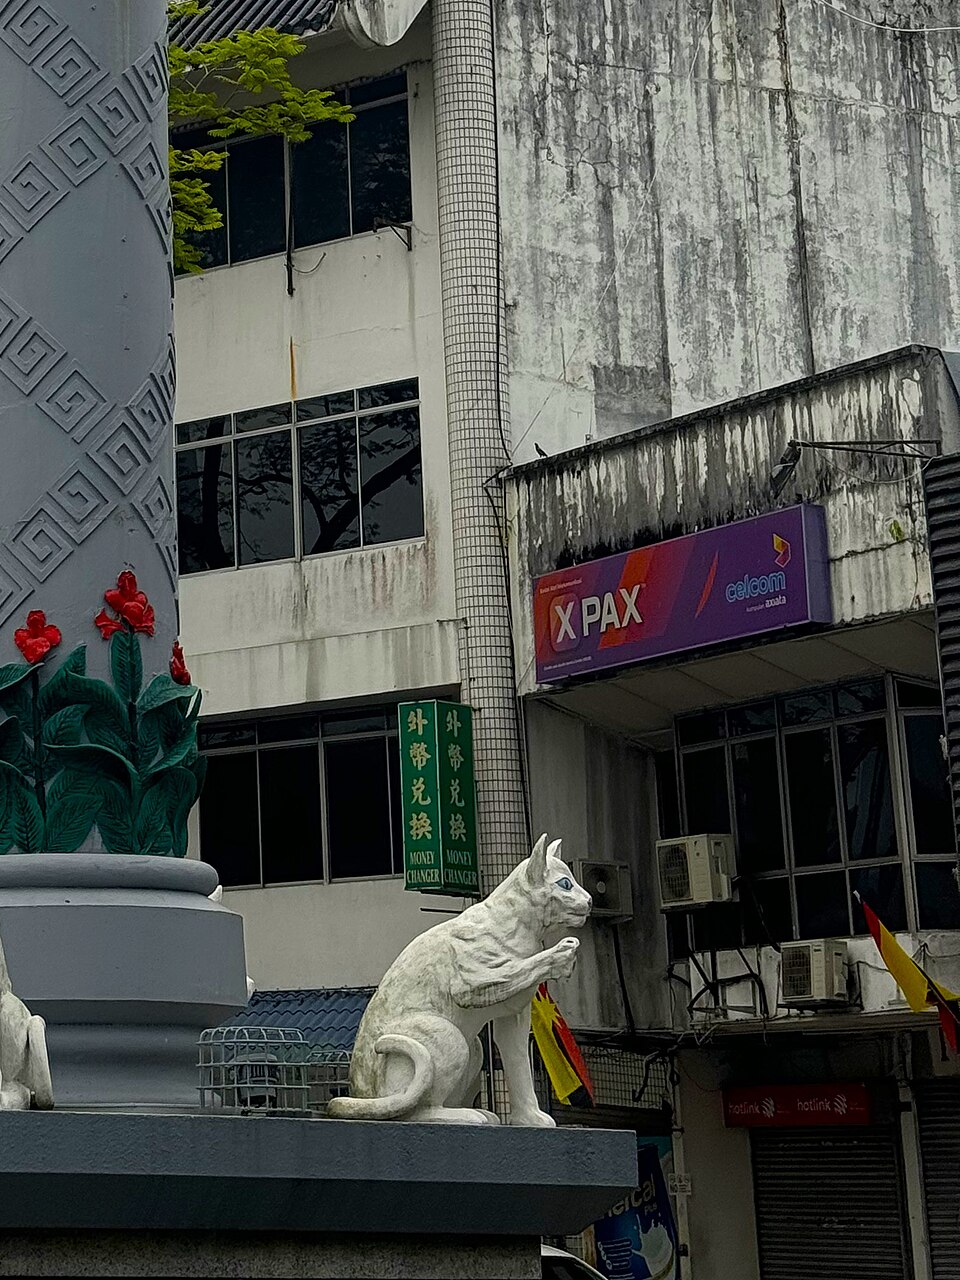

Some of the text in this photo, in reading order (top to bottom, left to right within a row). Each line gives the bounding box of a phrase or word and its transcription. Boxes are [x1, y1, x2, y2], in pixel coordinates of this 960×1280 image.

[725, 571, 787, 603] celcom
[409, 850, 436, 866] MONEY
[446, 849, 474, 867] MONEY
[406, 868, 440, 884] CHANGER
[443, 867, 478, 887] CHANGER
[796, 1097, 832, 1112] hotlink
